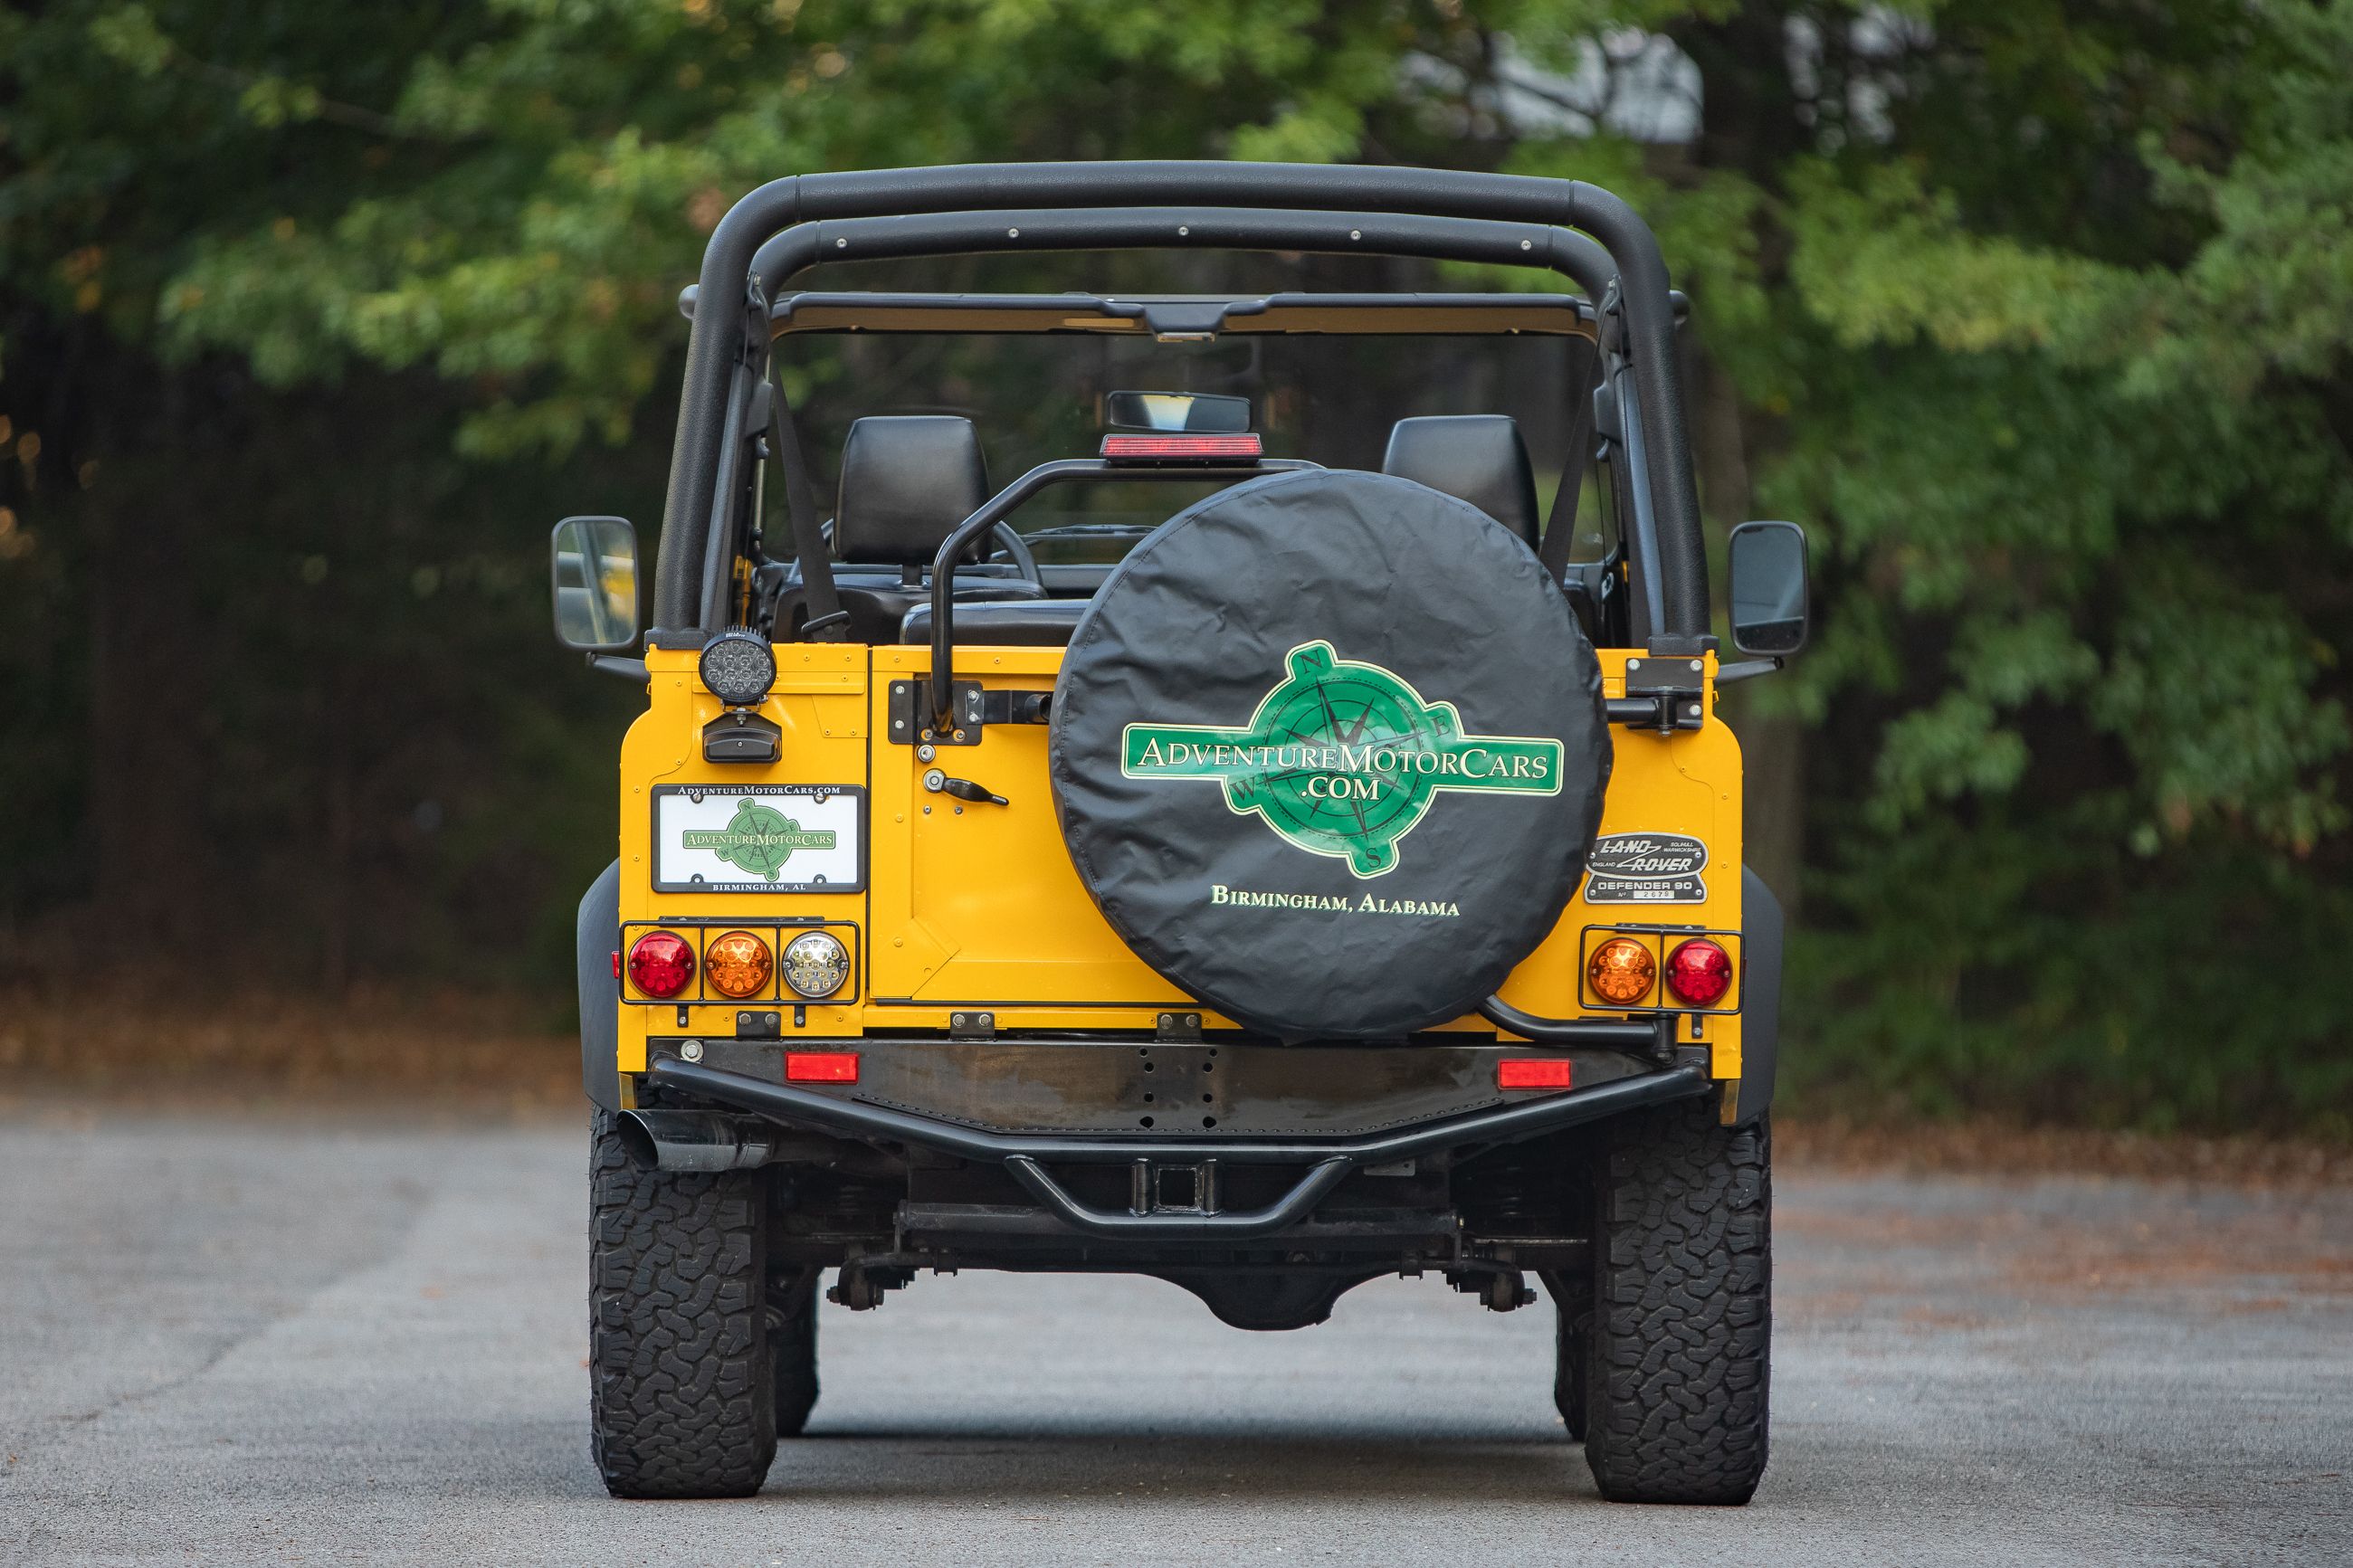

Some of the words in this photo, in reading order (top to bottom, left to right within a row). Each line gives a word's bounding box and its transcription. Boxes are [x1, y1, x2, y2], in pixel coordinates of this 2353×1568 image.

[1300, 649, 1325, 675] N
[1434, 715, 1452, 737] E
[1137, 736, 1548, 779] ADVENTUREMOTORCARS
[1231, 777, 1256, 802] W
[1300, 775, 1380, 802] .COM
[687, 834, 833, 846] ADVENTUREMOTORCARS
[1600, 840, 1652, 854] LAND
[1365, 847, 1381, 869] S
[1631, 858, 1693, 871] ROVER
[1597, 881, 1671, 890] DEFENDER
[1674, 881, 1692, 890] 90
[1211, 884, 1354, 914] BIRMINGHAM,
[1358, 892, 1461, 917] ALABAMA
